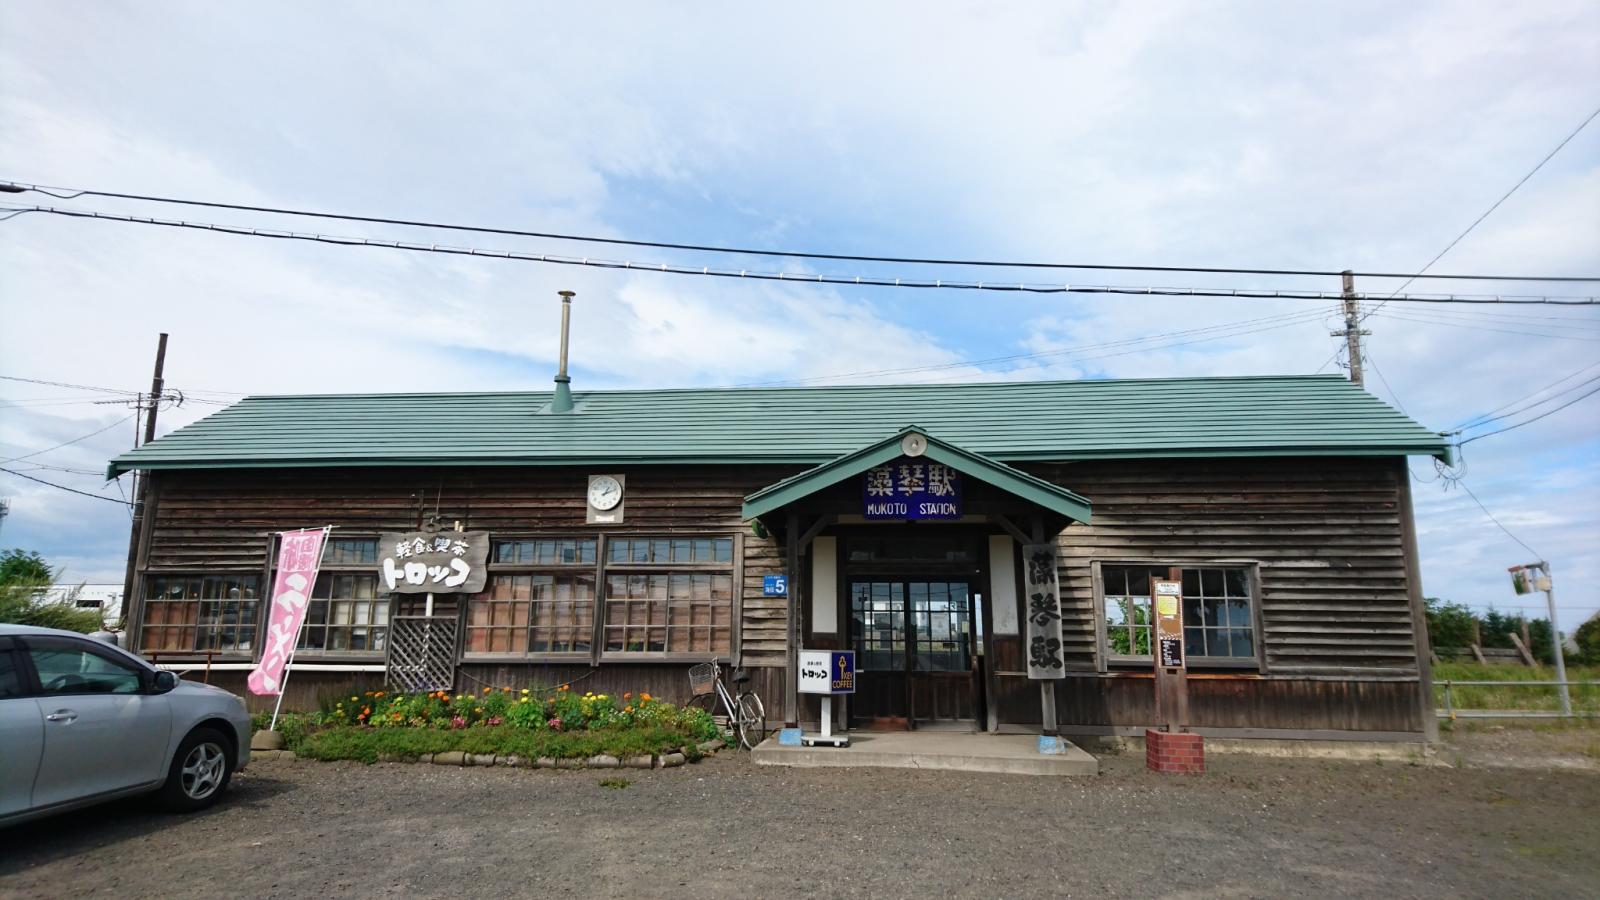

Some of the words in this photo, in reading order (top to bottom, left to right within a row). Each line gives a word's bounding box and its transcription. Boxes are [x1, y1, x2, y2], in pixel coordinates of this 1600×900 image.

[919, 502, 957, 515] STATION
[383, 558, 471, 591] トロッコ
[775, 579, 785, 594] 5
[801, 668, 827, 679] トロッコ
[832, 680, 852, 688] COFFEE
